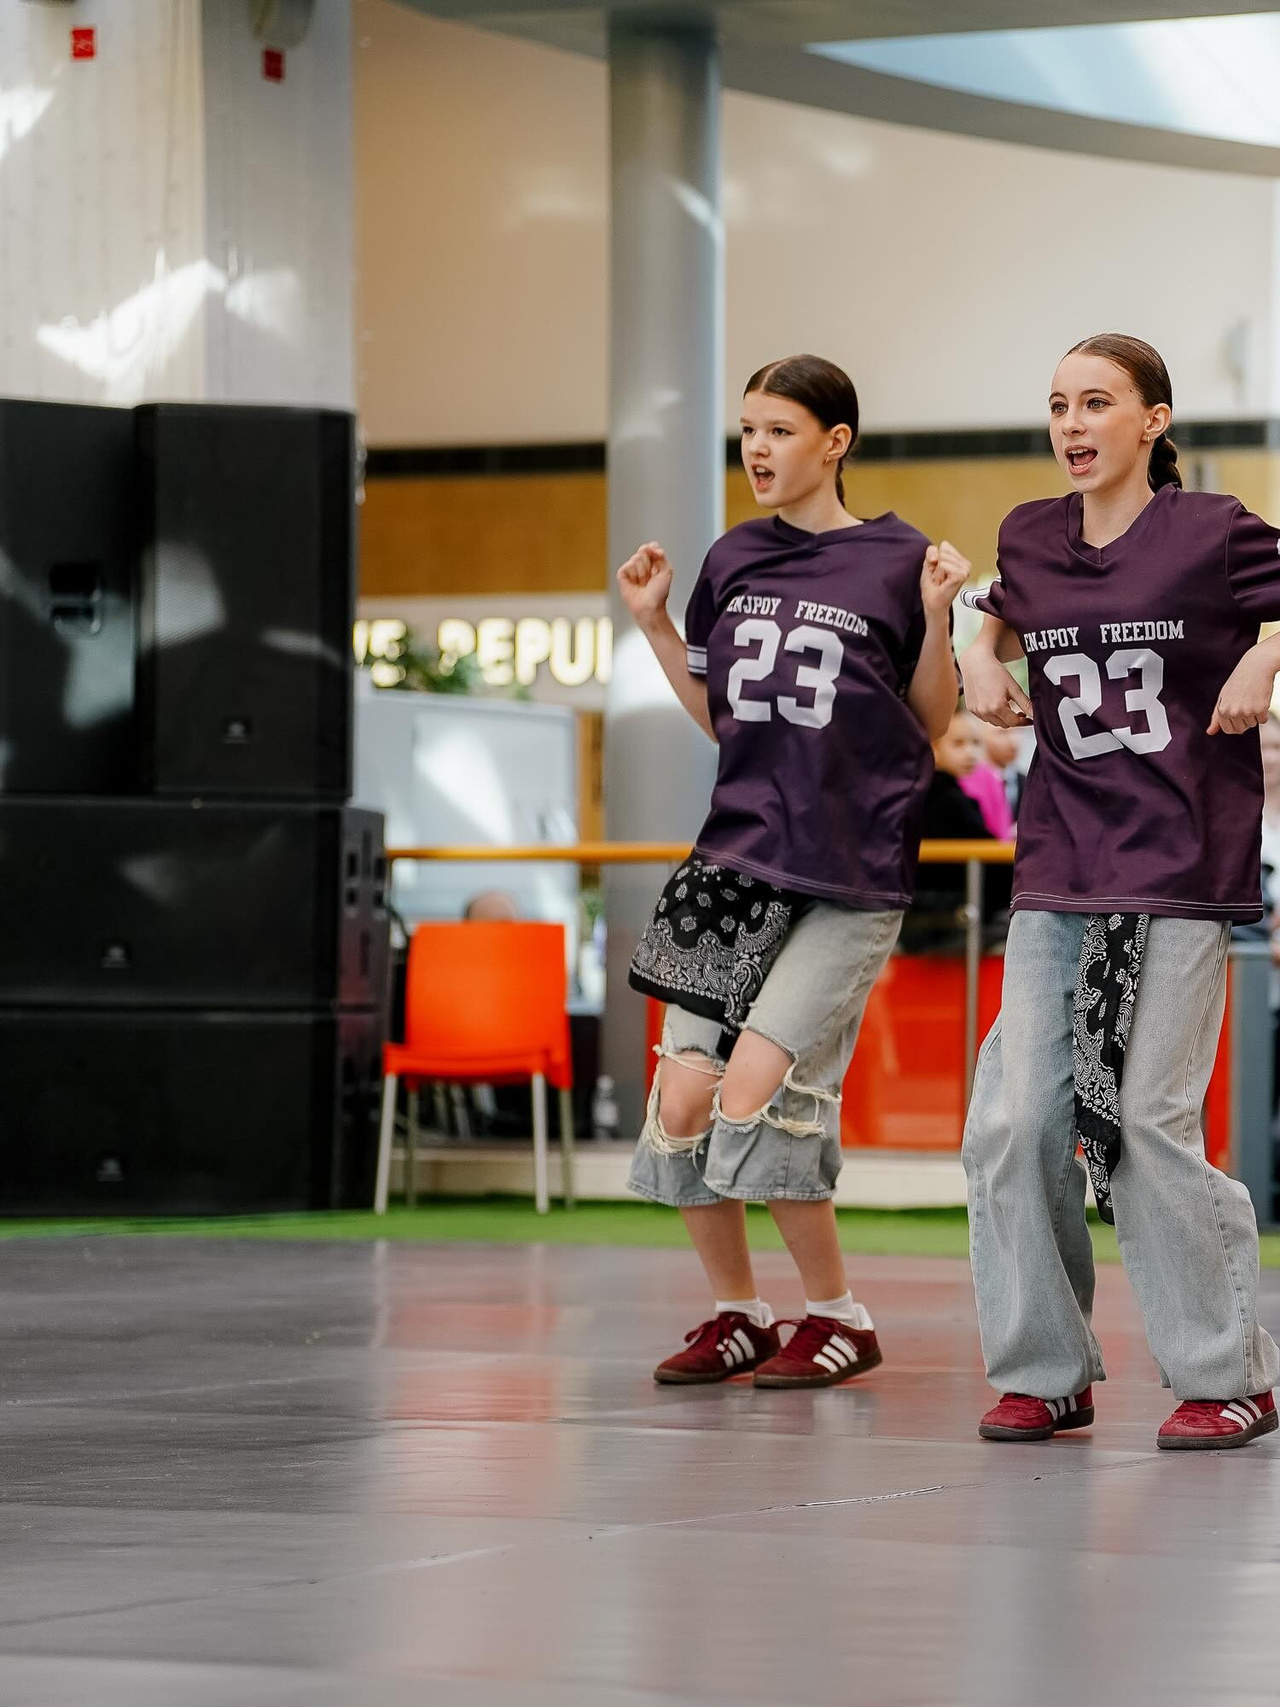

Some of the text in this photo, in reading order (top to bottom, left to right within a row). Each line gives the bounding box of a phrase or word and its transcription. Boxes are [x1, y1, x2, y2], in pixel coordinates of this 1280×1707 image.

[794, 600, 869, 637] FREEDOM
[1100, 620, 1185, 643] FREEDOM
[727, 618, 844, 730] 23
[1043, 648, 1172, 760] 23
